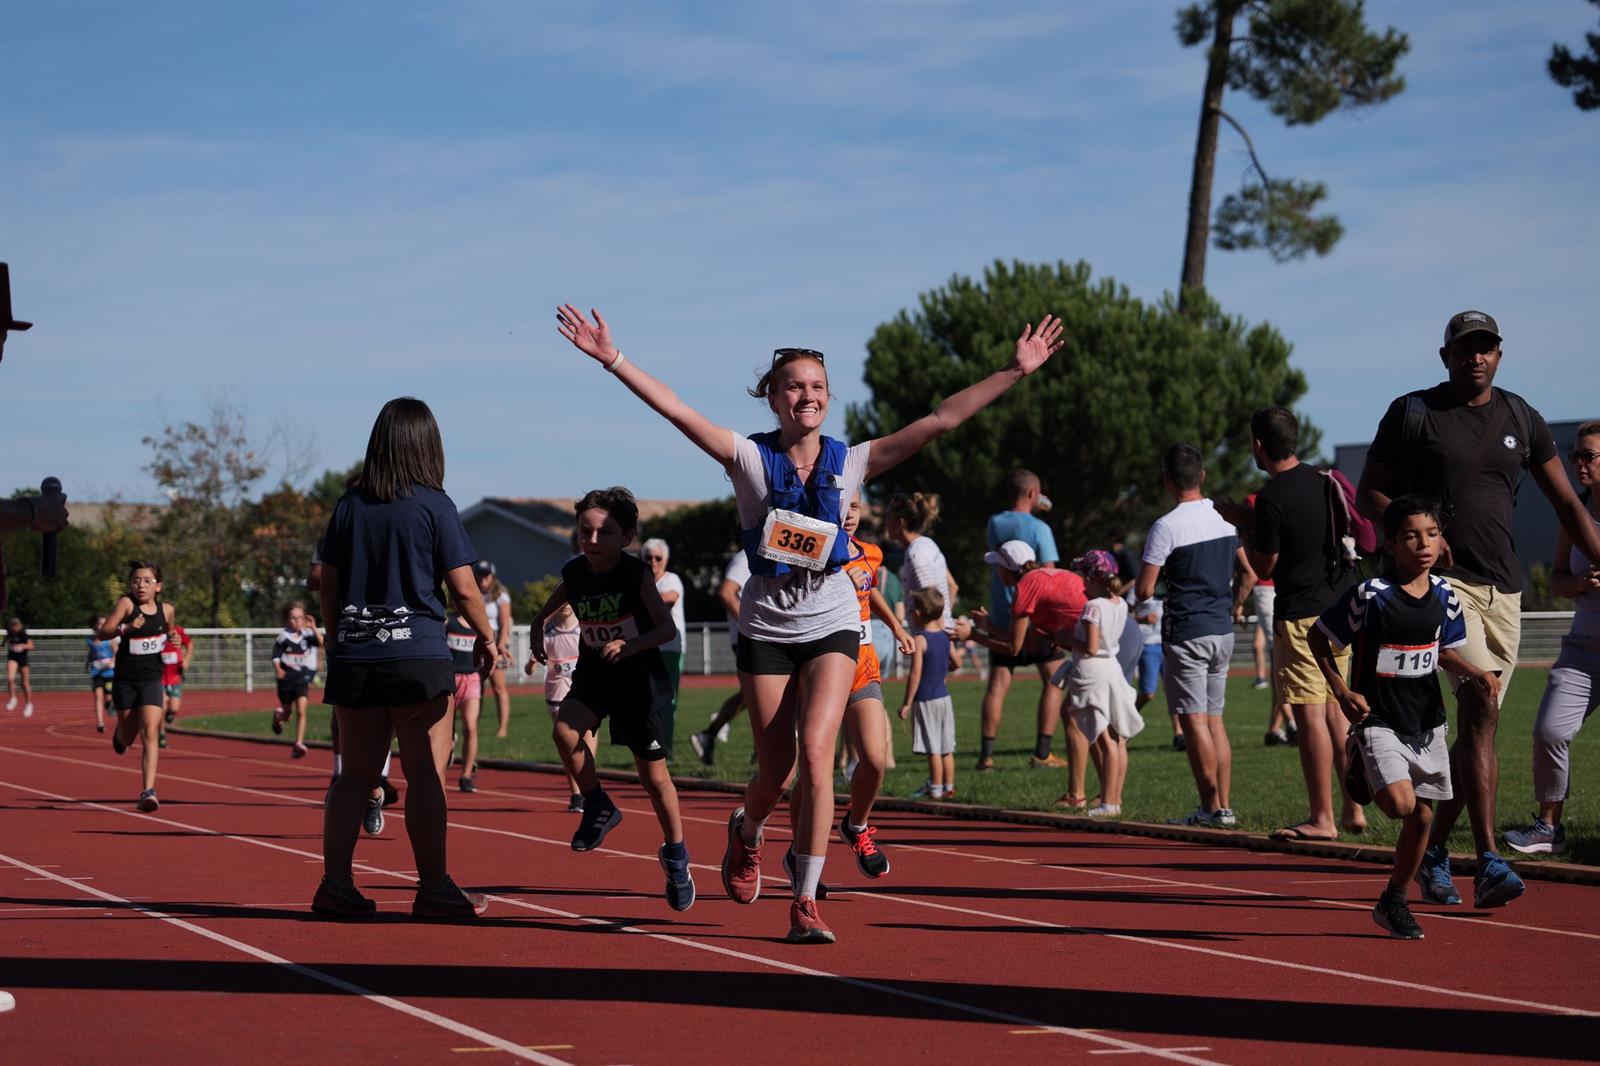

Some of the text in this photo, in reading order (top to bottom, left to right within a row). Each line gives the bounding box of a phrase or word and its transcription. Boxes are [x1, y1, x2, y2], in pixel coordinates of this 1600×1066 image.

[777, 529, 817, 553] 336
[577, 592, 623, 618] PLAY
[585, 626, 625, 643] 102
[142, 640, 157, 651] 95
[1394, 651, 1433, 670] 119
